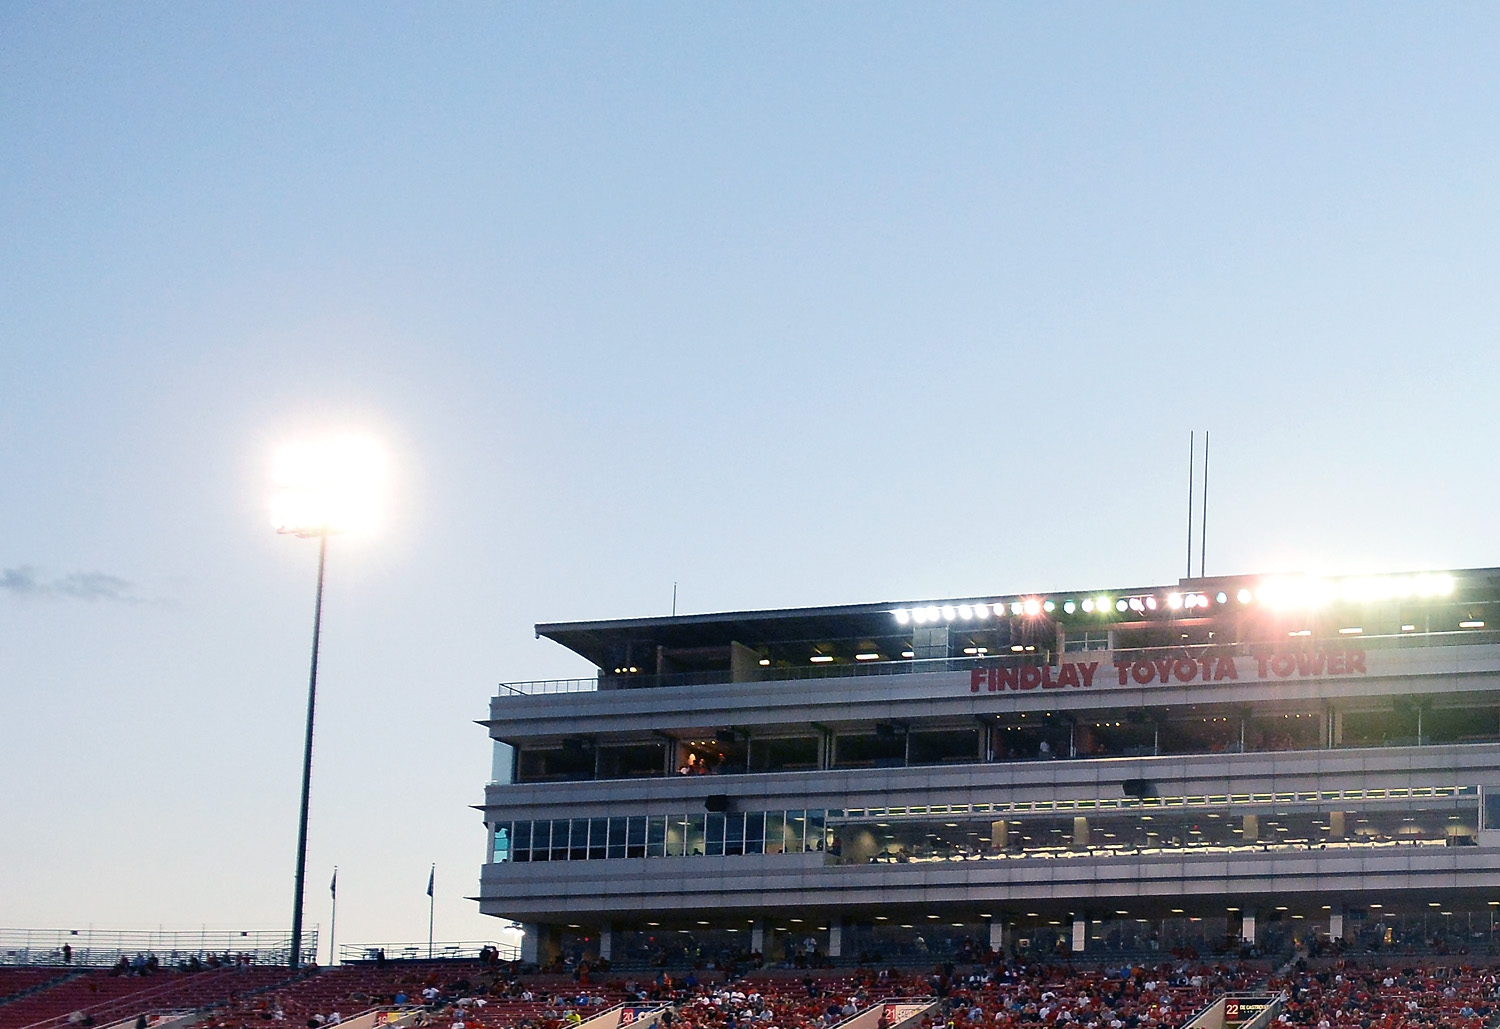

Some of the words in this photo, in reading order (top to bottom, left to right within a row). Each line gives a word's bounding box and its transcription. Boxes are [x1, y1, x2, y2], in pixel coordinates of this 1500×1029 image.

[970, 662, 1099, 692] FINDLAY
[1113, 654, 1239, 685] TOYOTA
[1252, 648, 1368, 678] TOWER
[885, 1008, 895, 1020] 21
[1226, 1004, 1239, 1015] 22
[622, 1012, 634, 1023] 20
